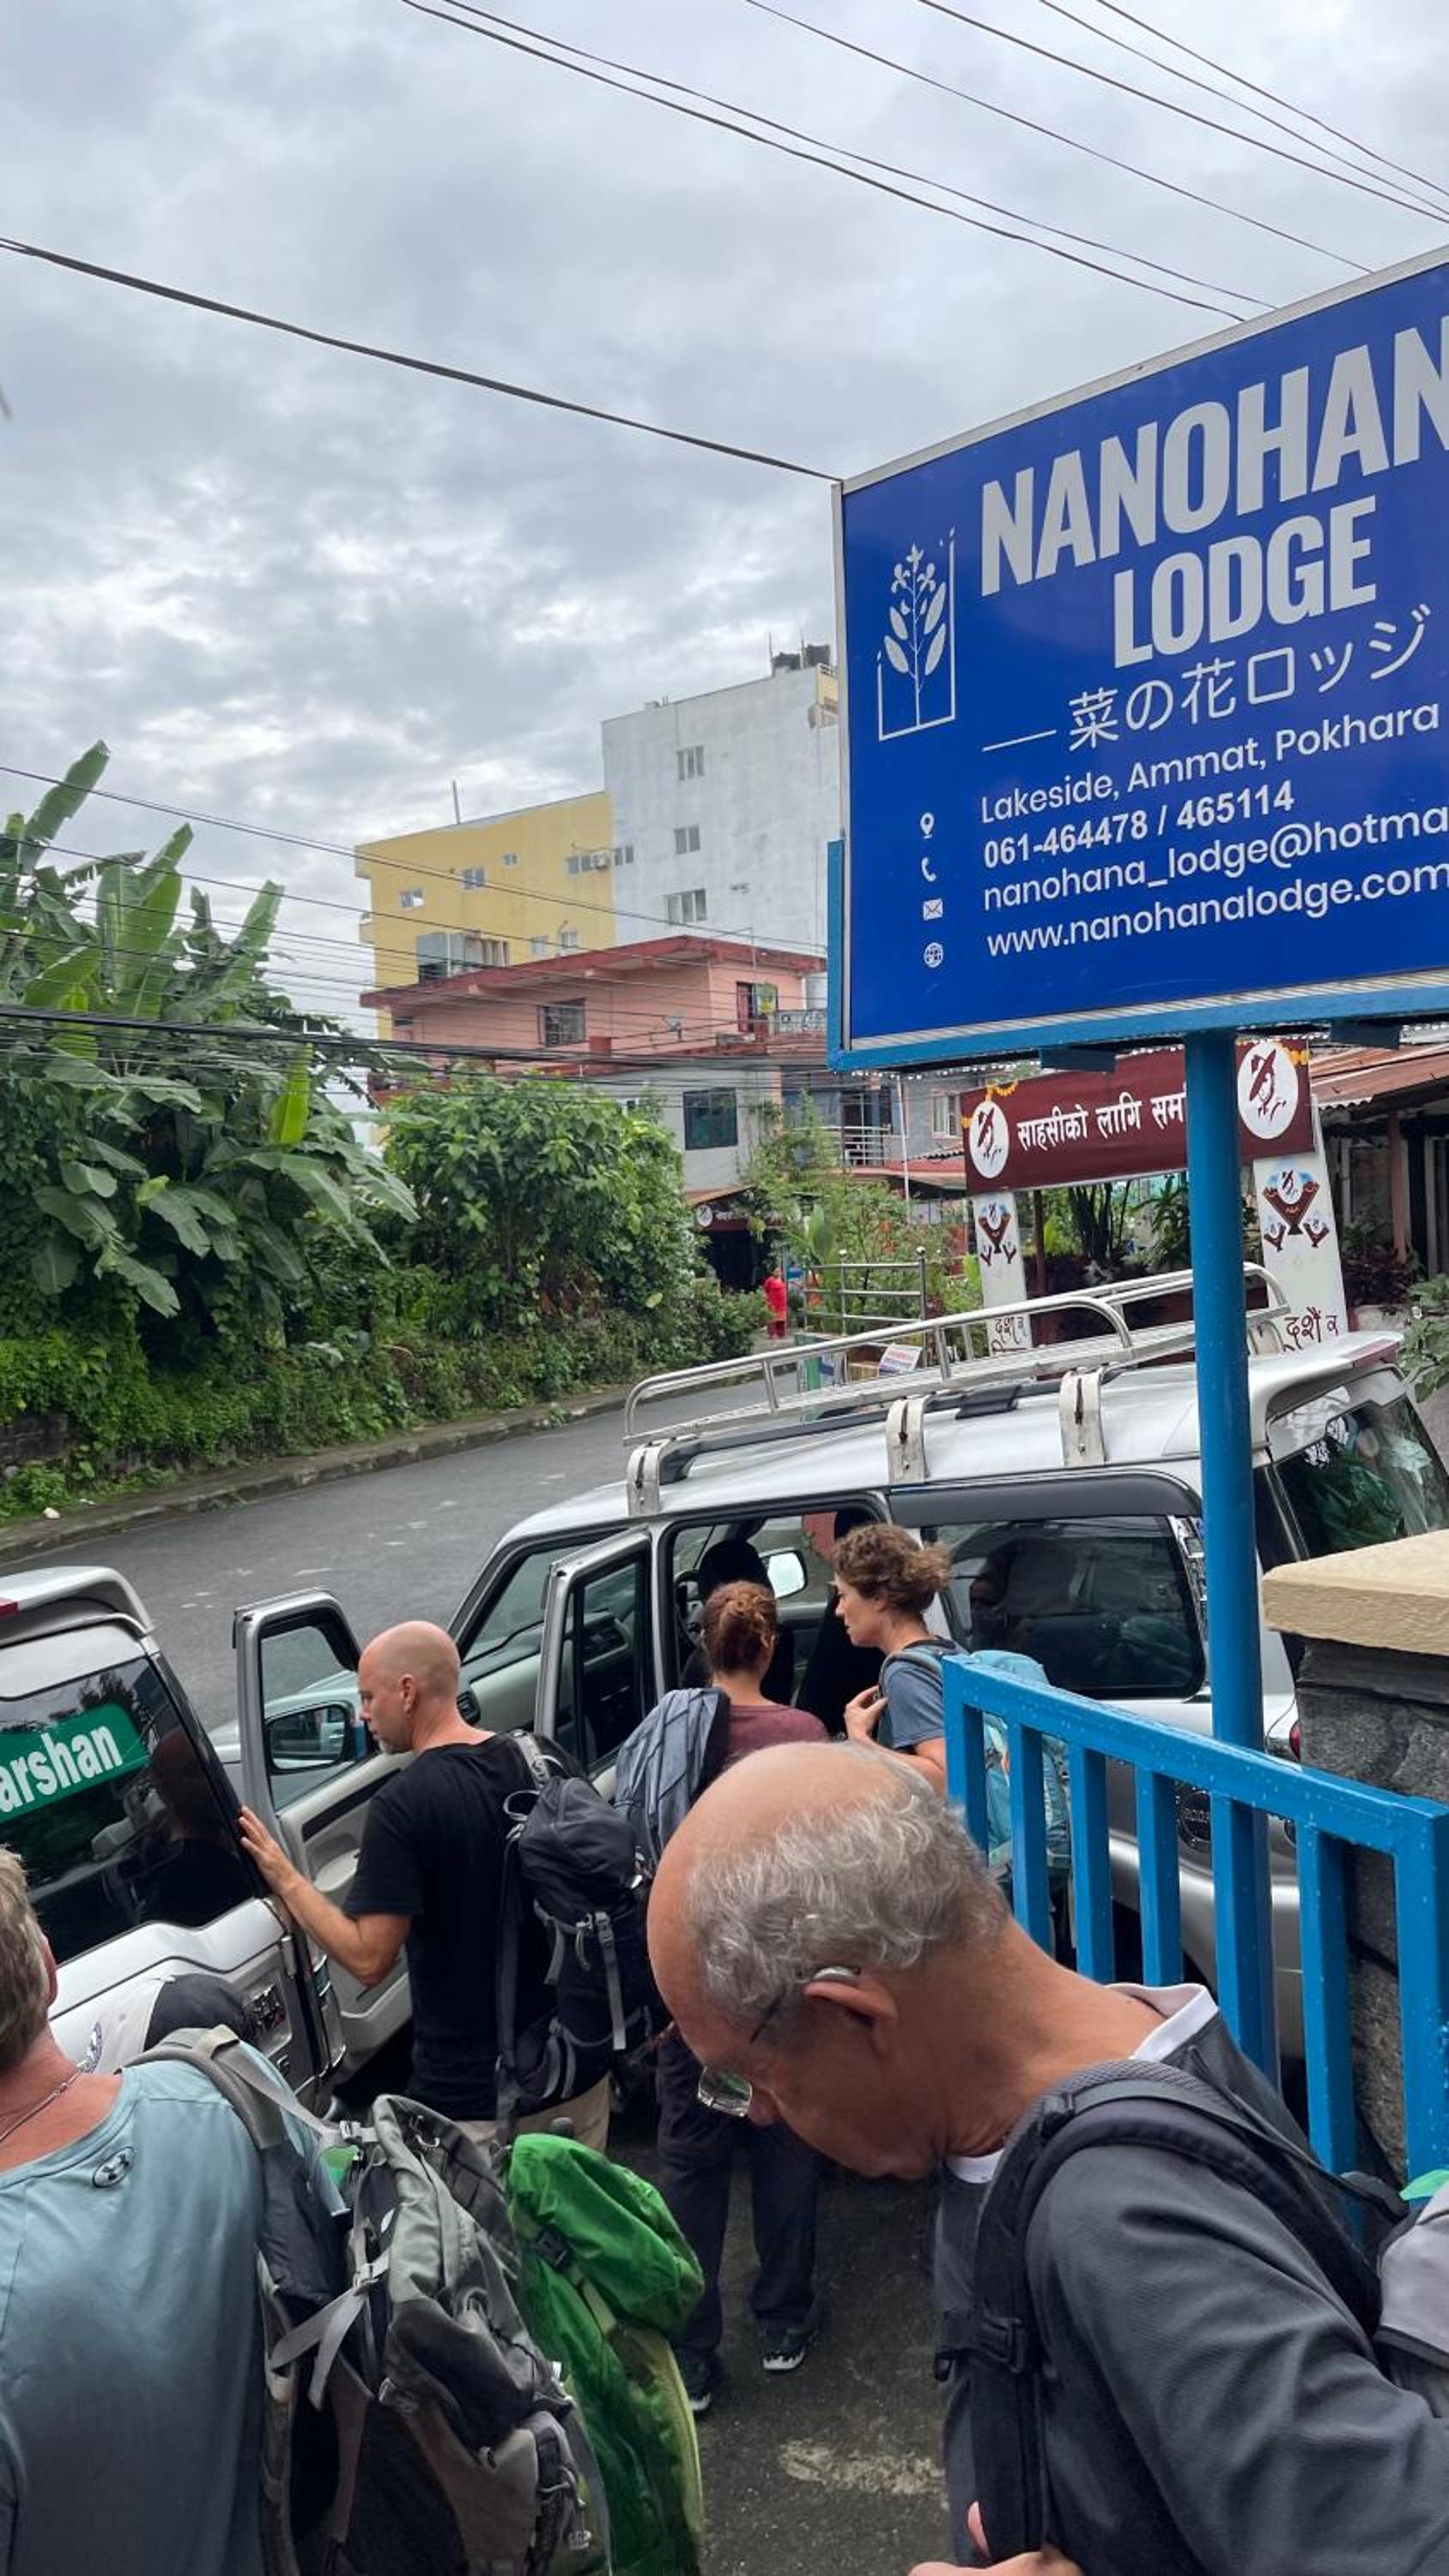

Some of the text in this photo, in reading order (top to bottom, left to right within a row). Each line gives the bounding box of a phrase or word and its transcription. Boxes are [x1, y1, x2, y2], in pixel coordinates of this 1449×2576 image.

[982, 314, 1449, 597] NANOHAN
[1113, 494, 1377, 669] LODGE
[1069, 604, 1431, 751] 菜の花ロッジ
[982, 703, 1439, 823] Lakeside, Ammat, Pokhara
[984, 780, 1295, 868] 061-464478 / 465114
[984, 806, 1449, 912] nanohana_lodge@hotma
[987, 863, 1449, 956] www.nanohanalodge.com
[1016, 1082, 1186, 1151] साहसीको लागि सम
